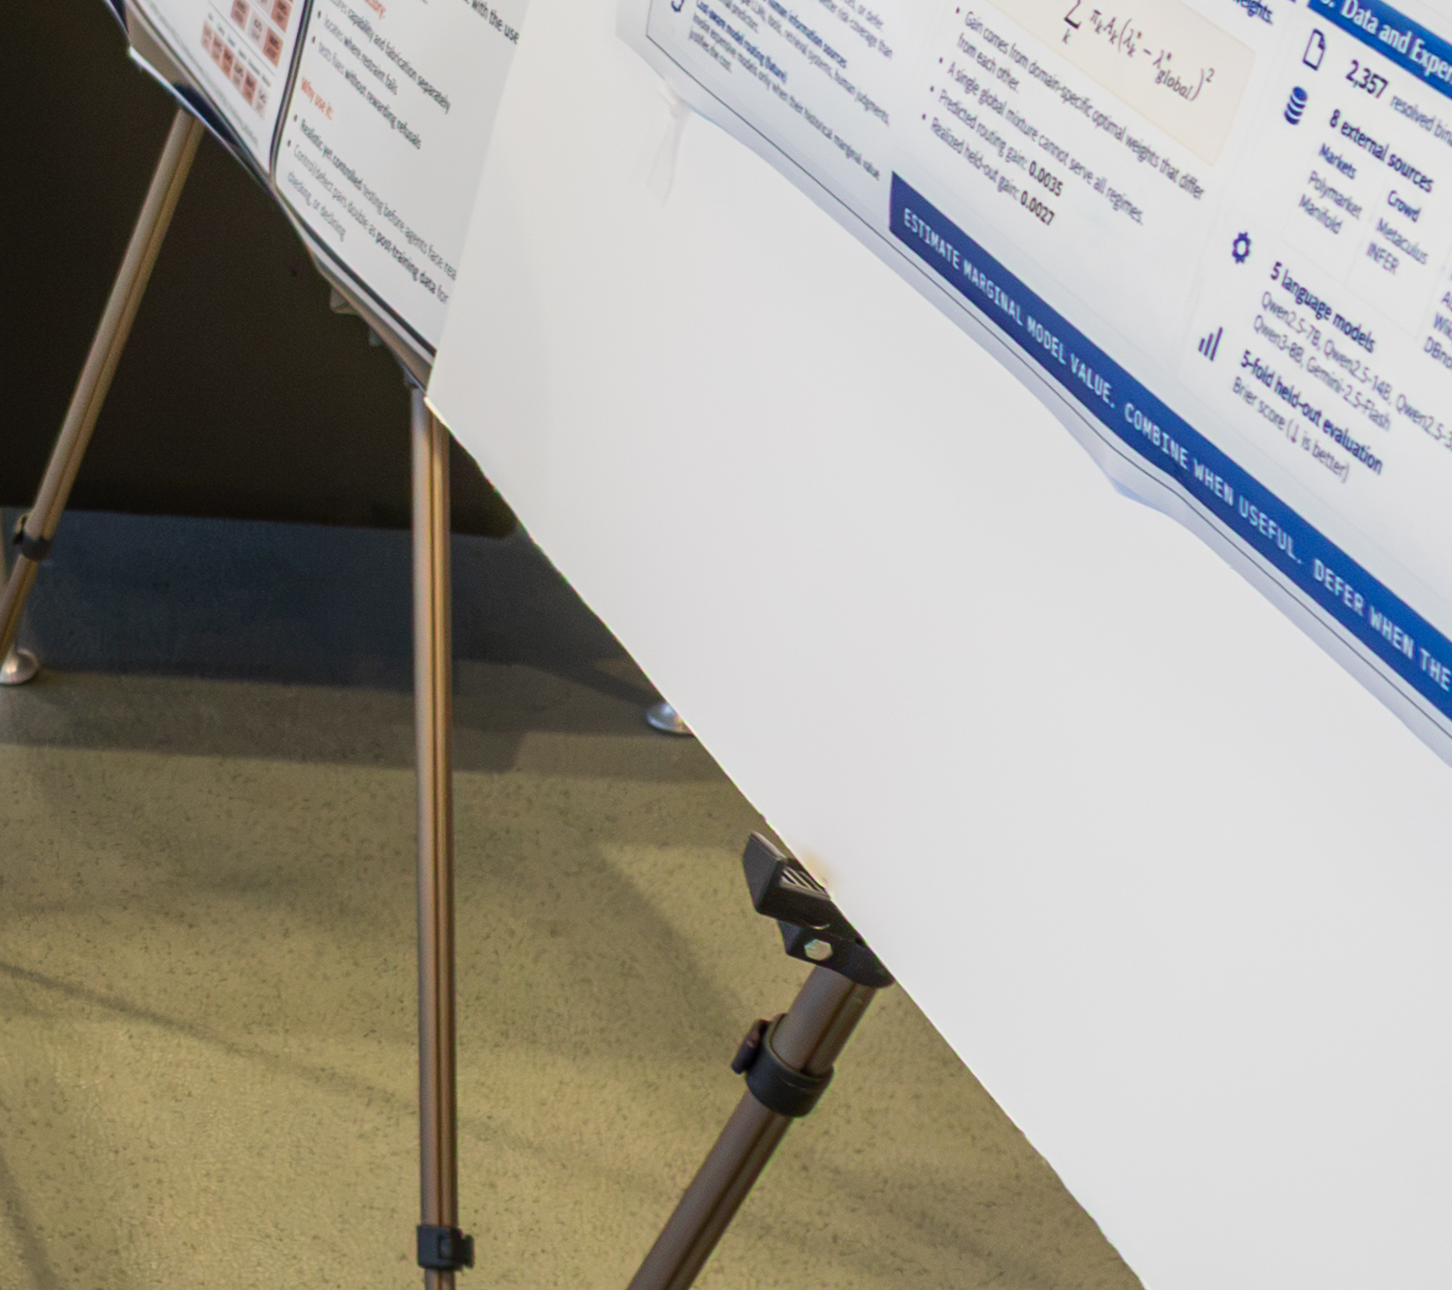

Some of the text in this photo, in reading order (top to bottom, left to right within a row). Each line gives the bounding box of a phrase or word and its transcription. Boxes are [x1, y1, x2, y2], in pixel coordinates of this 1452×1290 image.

[1345, 59, 1389, 99] 2,357
[1378, 25, 1411, 53] and
[1409, 38, 1452, 83] Exper
[1329, 109, 1432, 192] 8 external sources
[904, 208, 1450, 690] ESTIMATE MARGINAL MODEL VALUE. COMBINE WHEN USEFUL. DEFER WHEN THE
